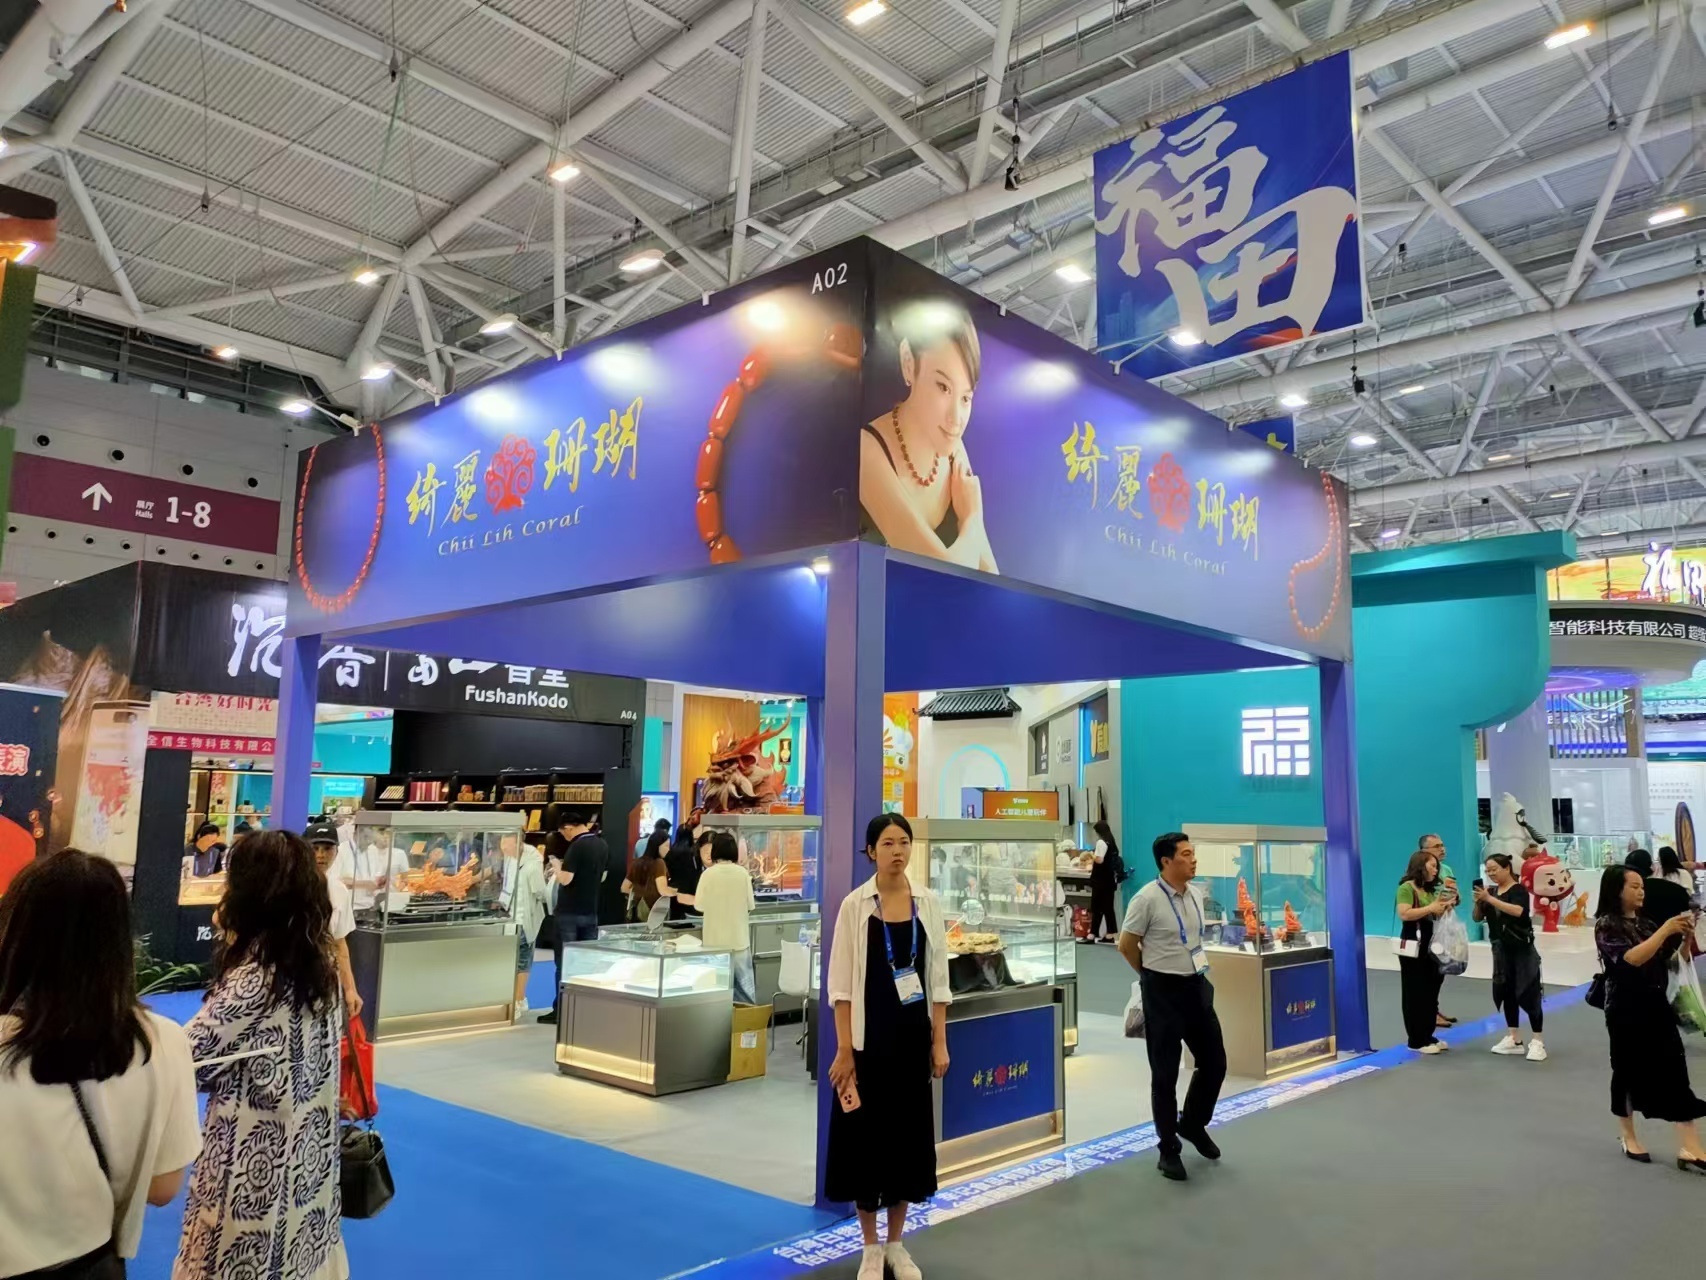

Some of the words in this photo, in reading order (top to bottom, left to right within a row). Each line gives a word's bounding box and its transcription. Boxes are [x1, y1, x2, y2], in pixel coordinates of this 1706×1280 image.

[1094, 105, 1358, 346] 福田
[811, 262, 848, 295] A02
[166, 496, 211, 528] 1-8
[438, 537, 475, 556] Chii
[481, 523, 514, 547] Lih
[522, 505, 586, 537] Coral
[1105, 524, 1143, 549] Chii
[1151, 540, 1177, 561] Lih
[1183, 551, 1228, 576] Coral
[1549, 619, 1686, 639] 智能科技有限公司
[465, 685, 569, 709] FushanKodo
[620, 710, 638, 721] A04
